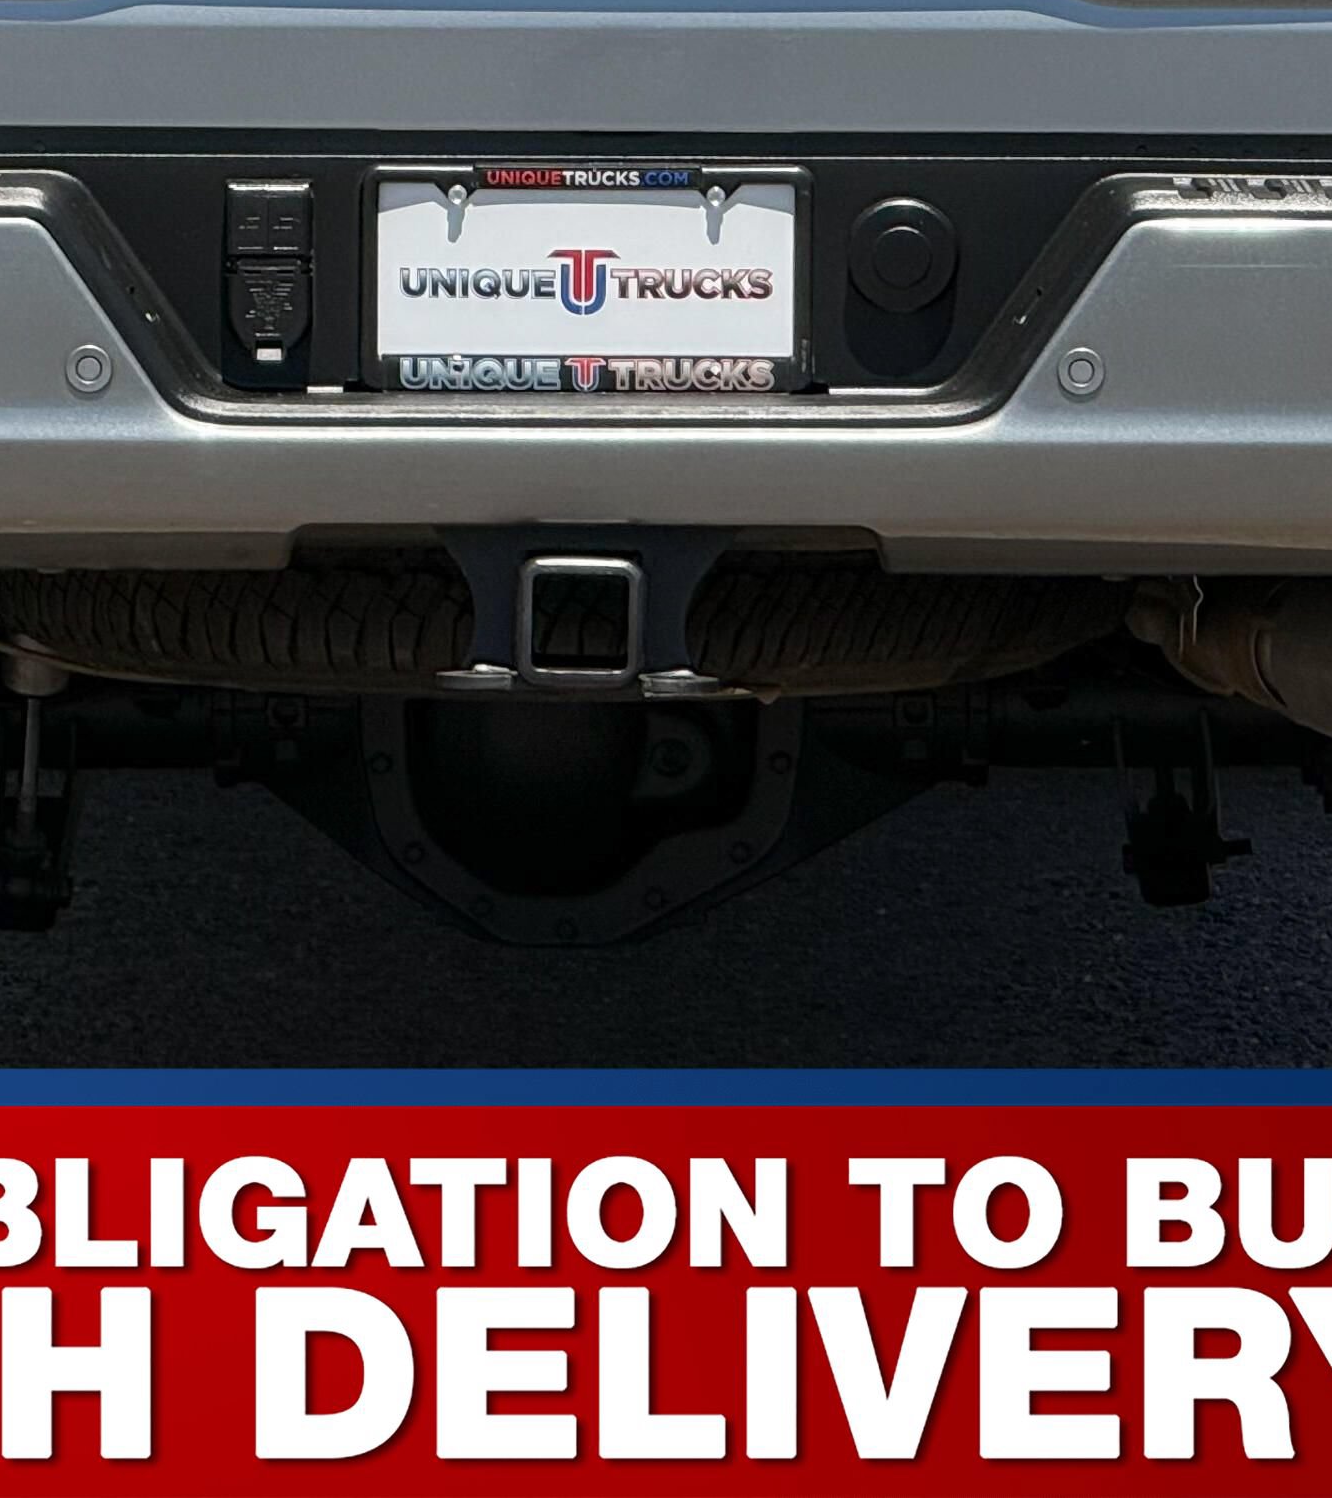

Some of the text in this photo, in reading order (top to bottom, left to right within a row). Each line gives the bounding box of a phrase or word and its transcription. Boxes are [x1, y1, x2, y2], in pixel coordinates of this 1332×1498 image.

[486, 169, 689, 187] UNIQUETRUCKS.COM
[399, 266, 557, 300] UNIQUE
[609, 267, 775, 300] TRUCKS
[400, 357, 561, 391] UNIQUE
[608, 357, 776, 392] TRUCKS
